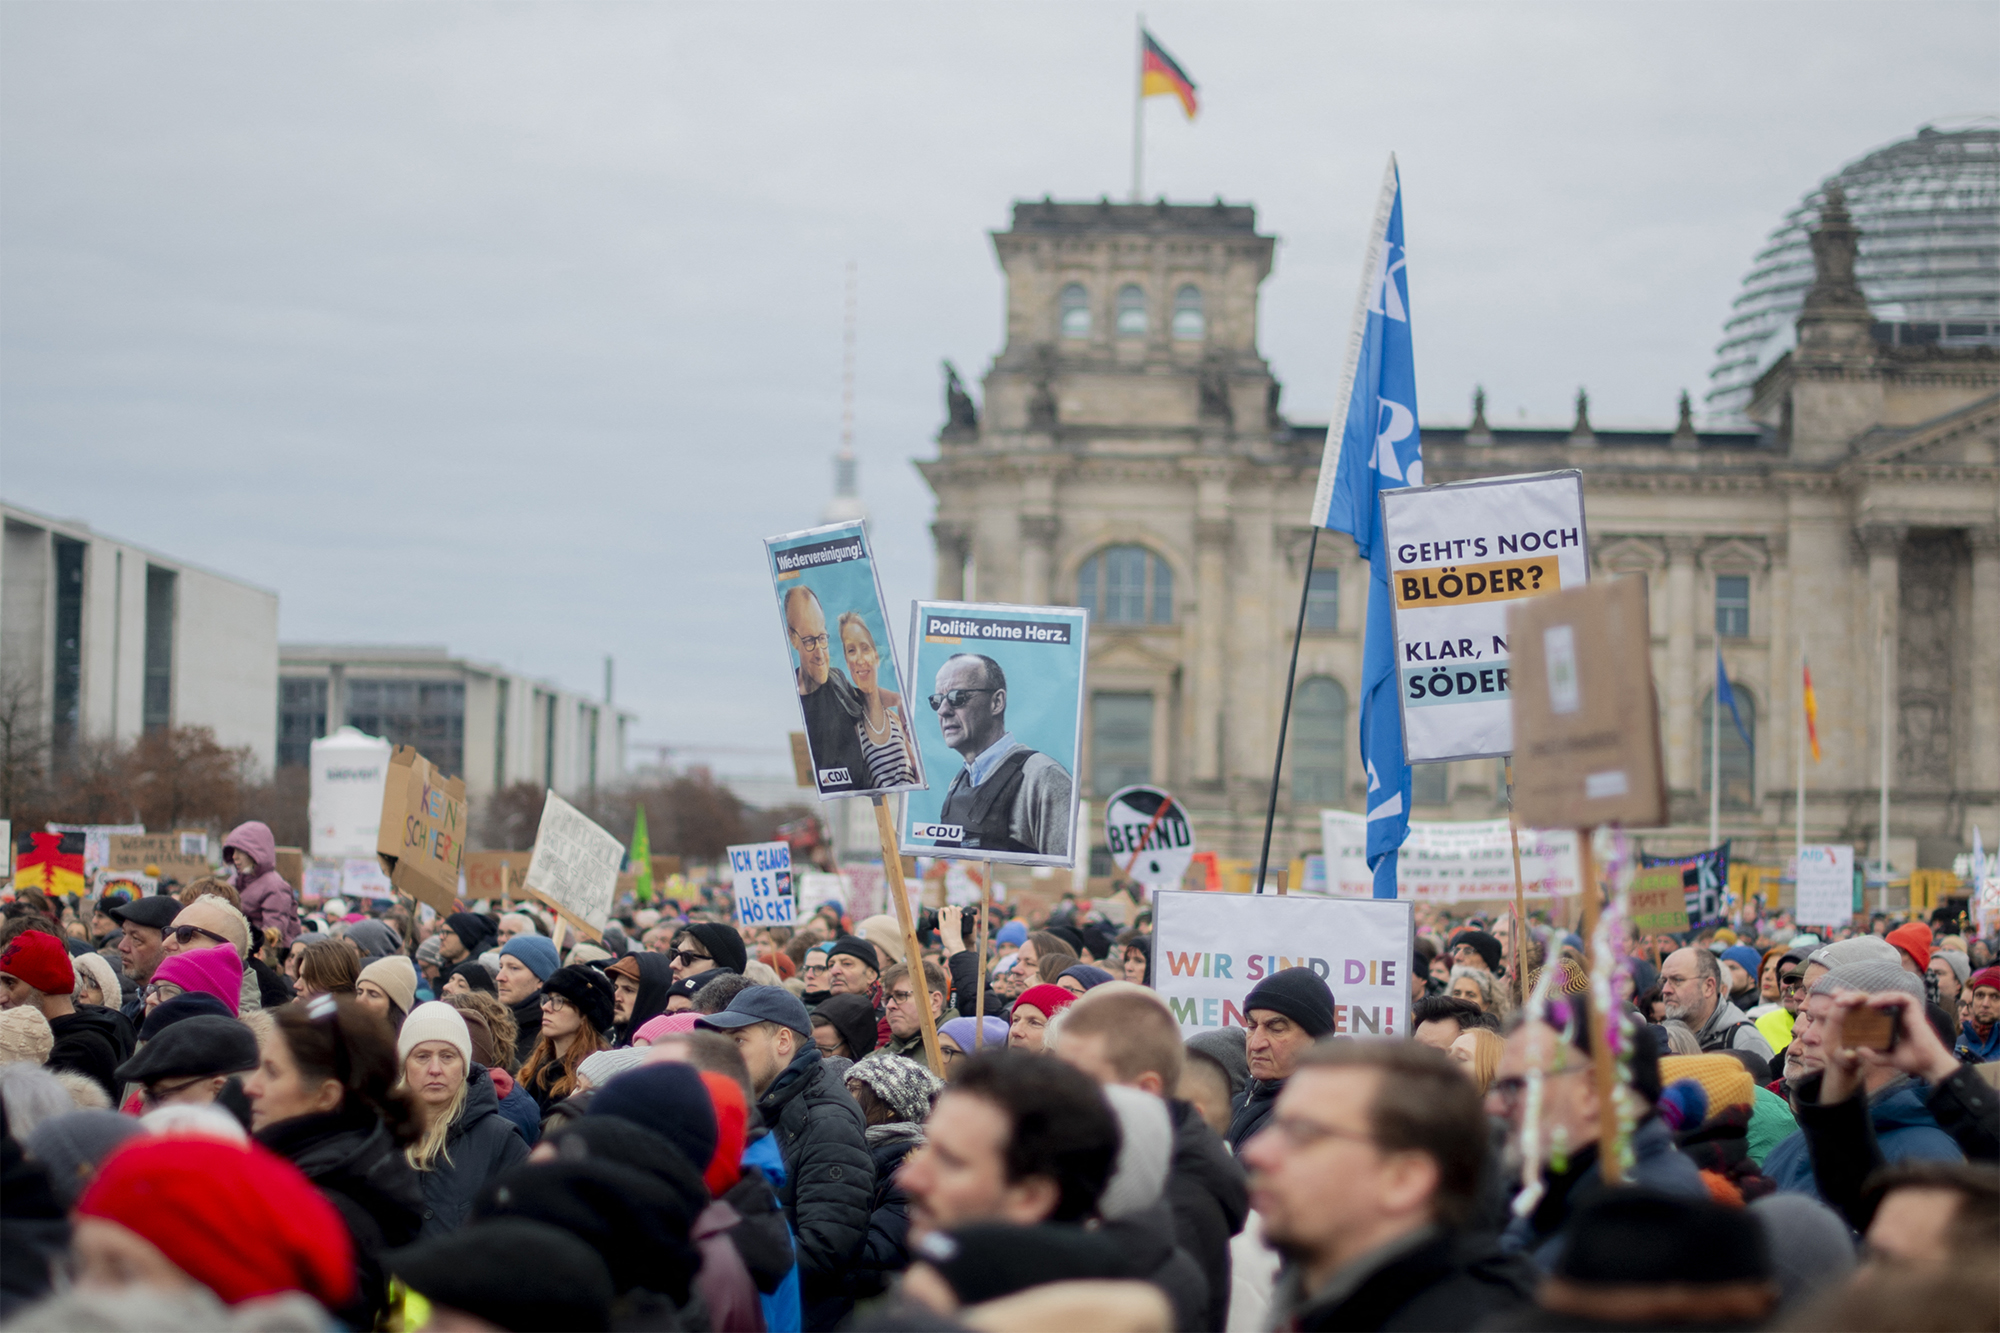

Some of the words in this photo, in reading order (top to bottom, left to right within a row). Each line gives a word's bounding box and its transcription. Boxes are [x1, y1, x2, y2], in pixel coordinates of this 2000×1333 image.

[776, 540, 863, 570] Wiedervereinigung!
[1397, 537, 1488, 563] GEHT'S
[1497, 527, 1579, 555] NOCH
[1401, 565, 1544, 601] BLÖDER?
[929, 619, 980, 637] Politik
[982, 623, 1022, 639] ohne
[1024, 625, 1068, 642] Herz.
[1405, 638, 1482, 662] KLAR,
[1492, 634, 1511, 655] N
[827, 770, 849, 783] CDU
[421, 782, 458, 832] KEIN
[925, 825, 961, 839] CDU
[1108, 818, 1191, 854] BERND
[731, 850, 752, 873] ICH
[756, 846, 790, 872] GLAUB
[751, 877, 770, 897] ES
[739, 896, 792, 924] HÖCKT
[1166, 950, 1234, 979] WIR
[1343, 958, 1397, 987] DIE
[1169, 996, 1394, 1036] MENEN!
